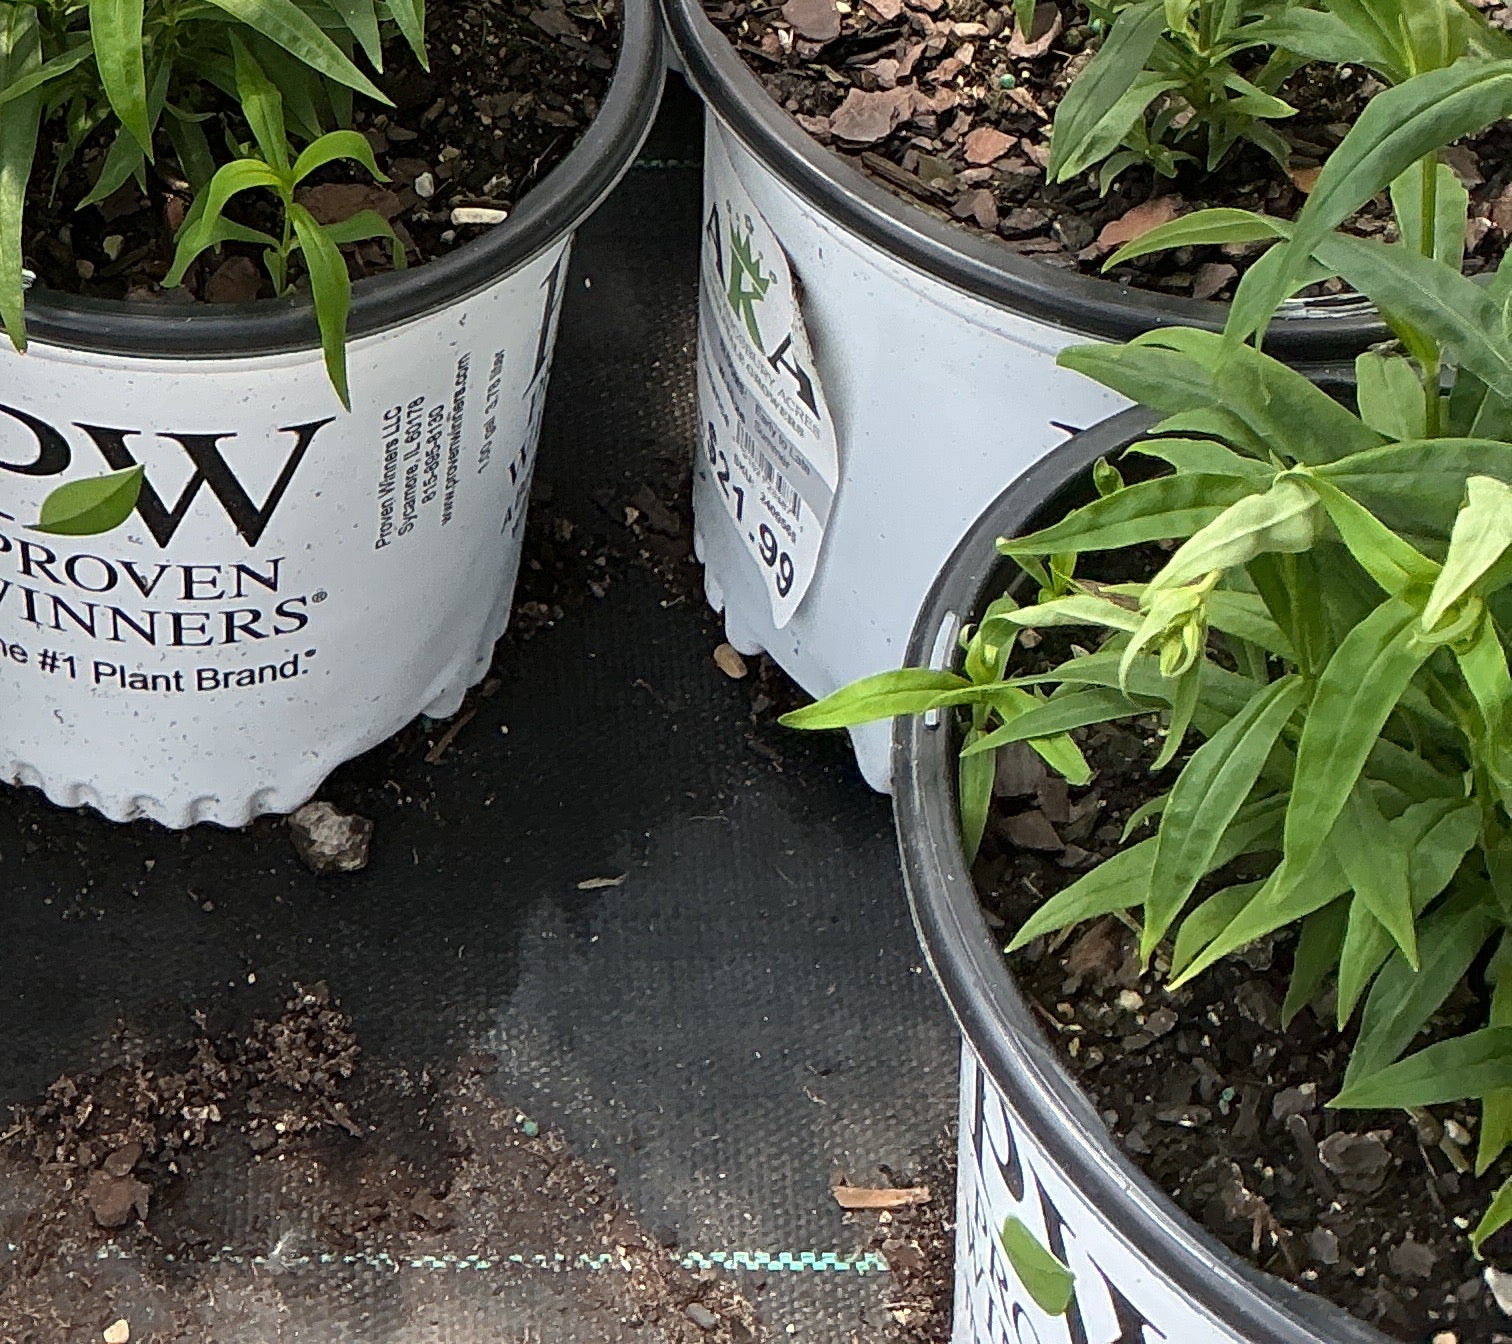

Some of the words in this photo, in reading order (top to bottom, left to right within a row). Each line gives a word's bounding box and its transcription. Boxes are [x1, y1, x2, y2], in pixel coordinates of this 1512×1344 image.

[382, 405, 402, 440] LLC
[377, 438, 400, 500] Winners
[374, 499, 394, 550] Proven
[707, 420, 794, 598] $21.99
[38, 649, 78, 679] #1
[92, 659, 184, 692] Plant
